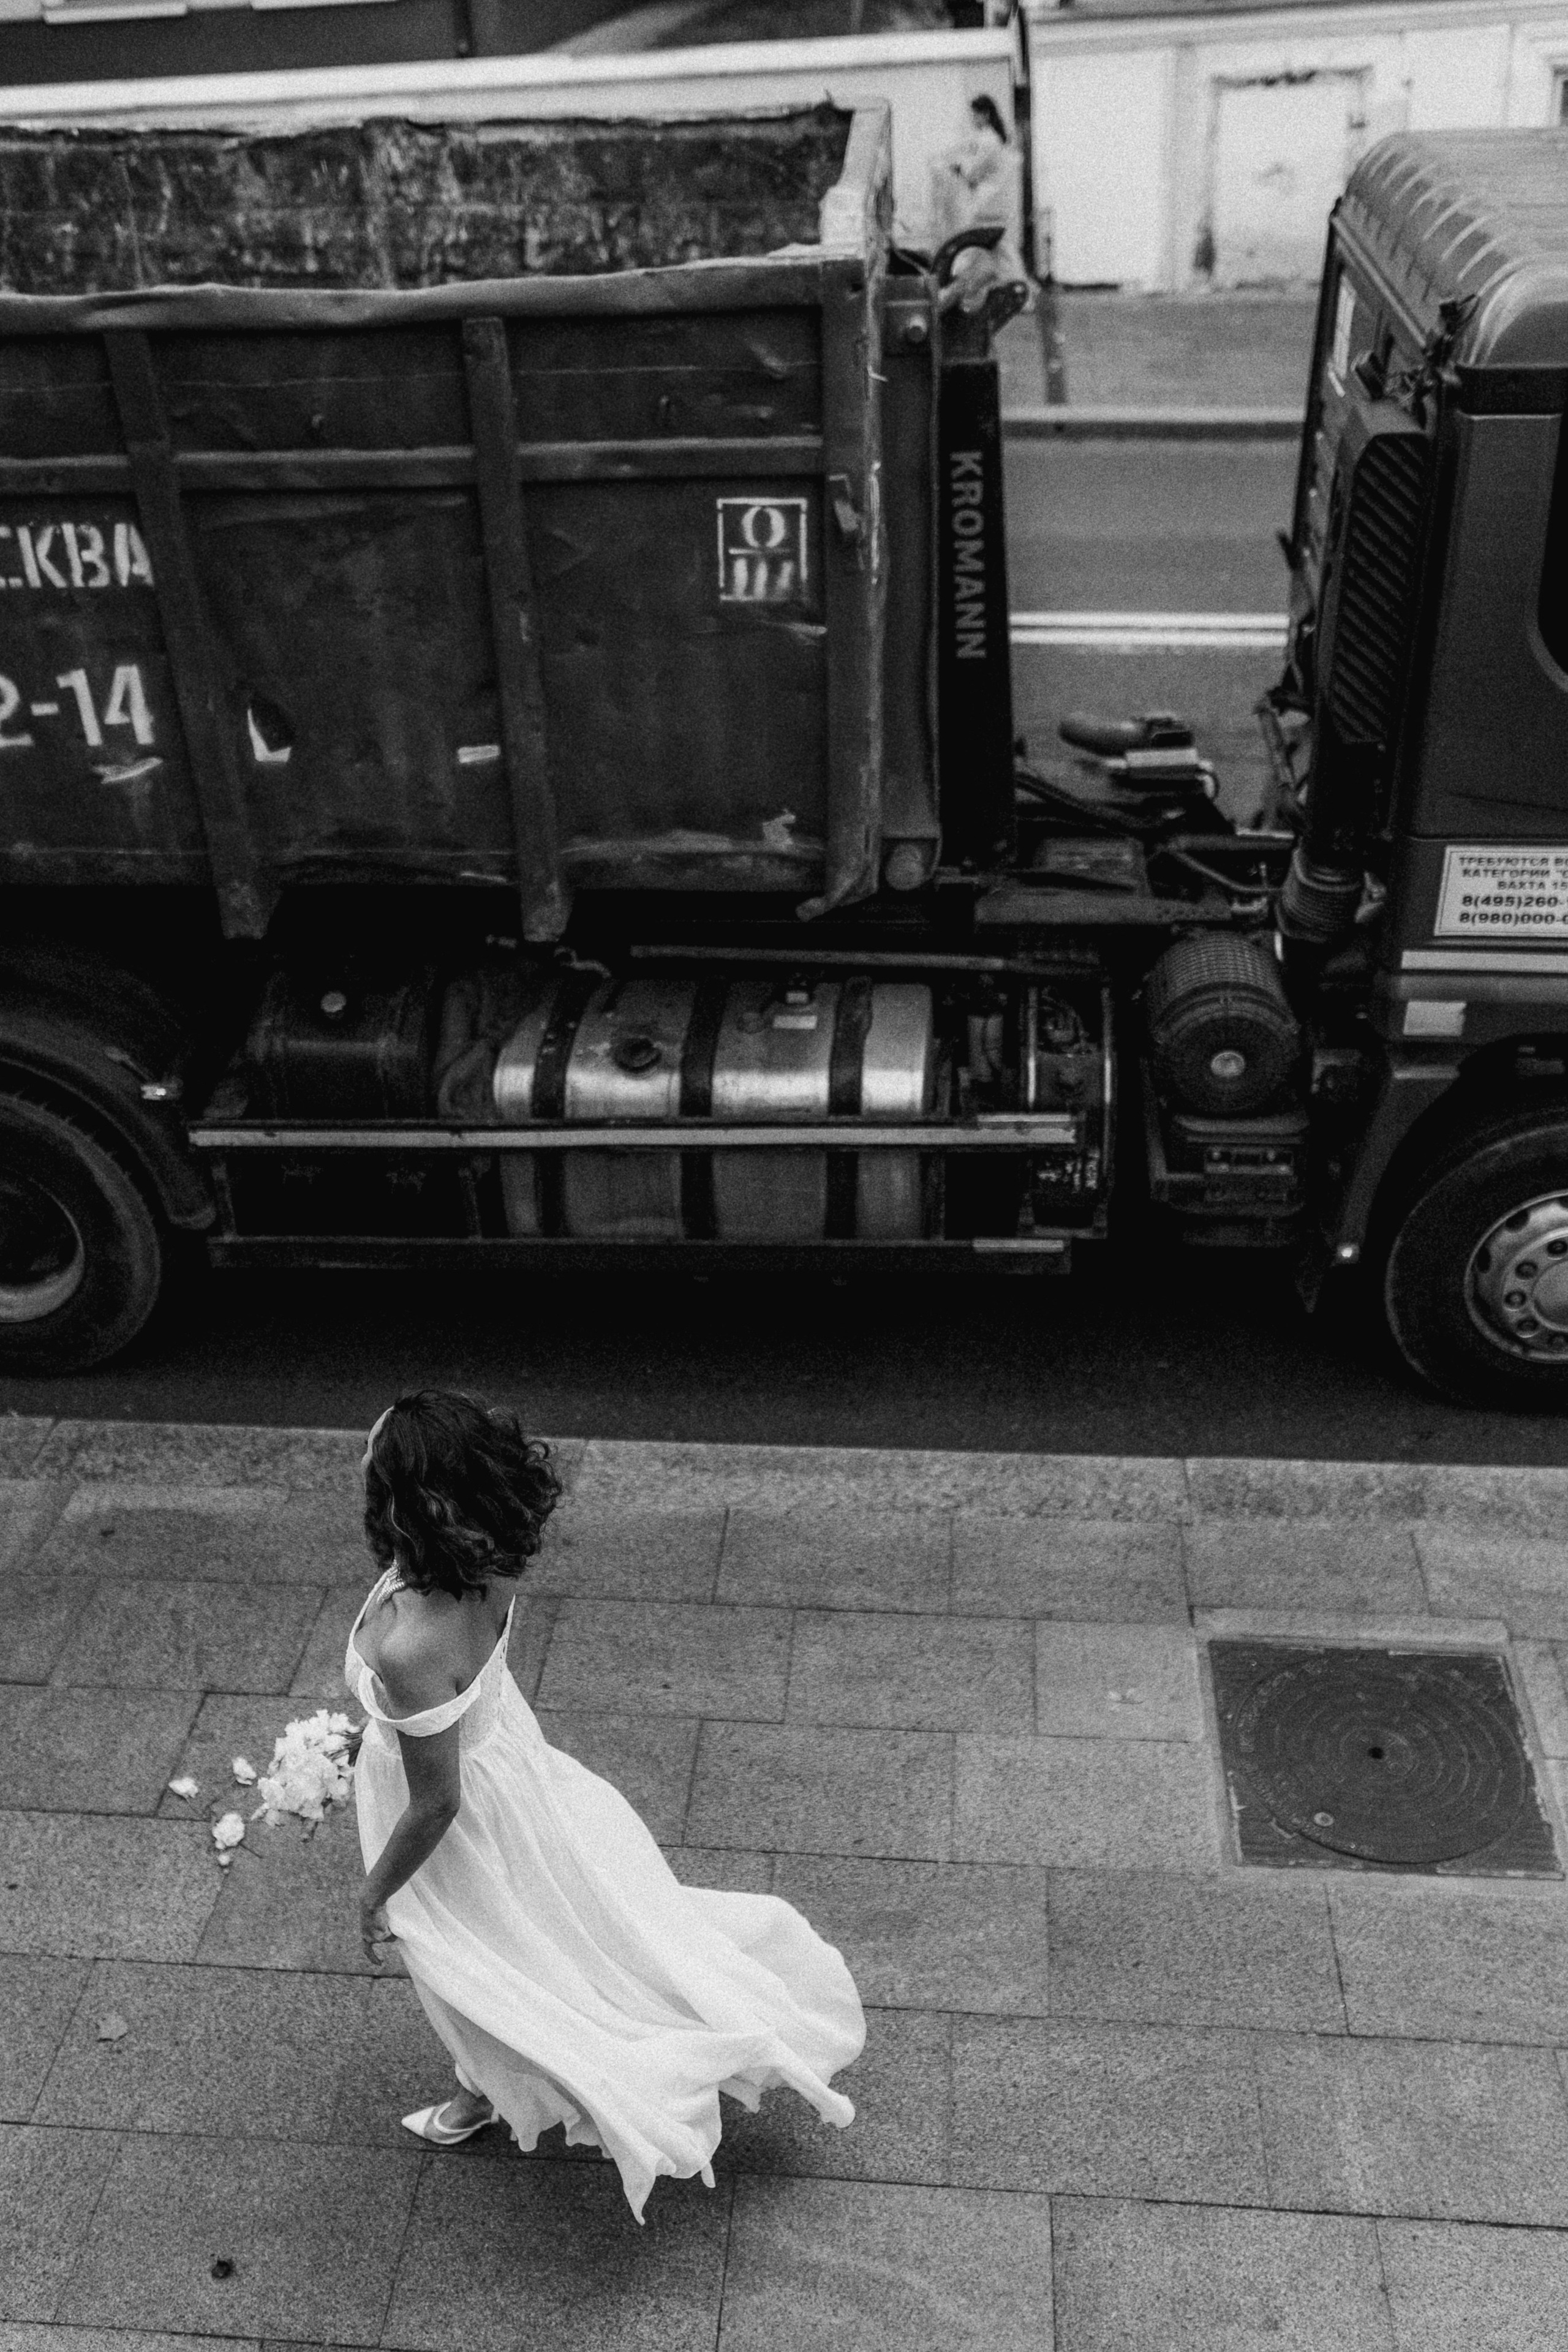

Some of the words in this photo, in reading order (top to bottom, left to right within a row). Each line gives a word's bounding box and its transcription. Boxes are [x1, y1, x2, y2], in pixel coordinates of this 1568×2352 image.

[950, 451, 986, 660] KROMANN
[1459, 857, 1548, 866] ТРЕБУЮТСЯ
[1498, 881, 1545, 890] ВАХТА
[1462, 895, 1568, 908] 8(495)260-
